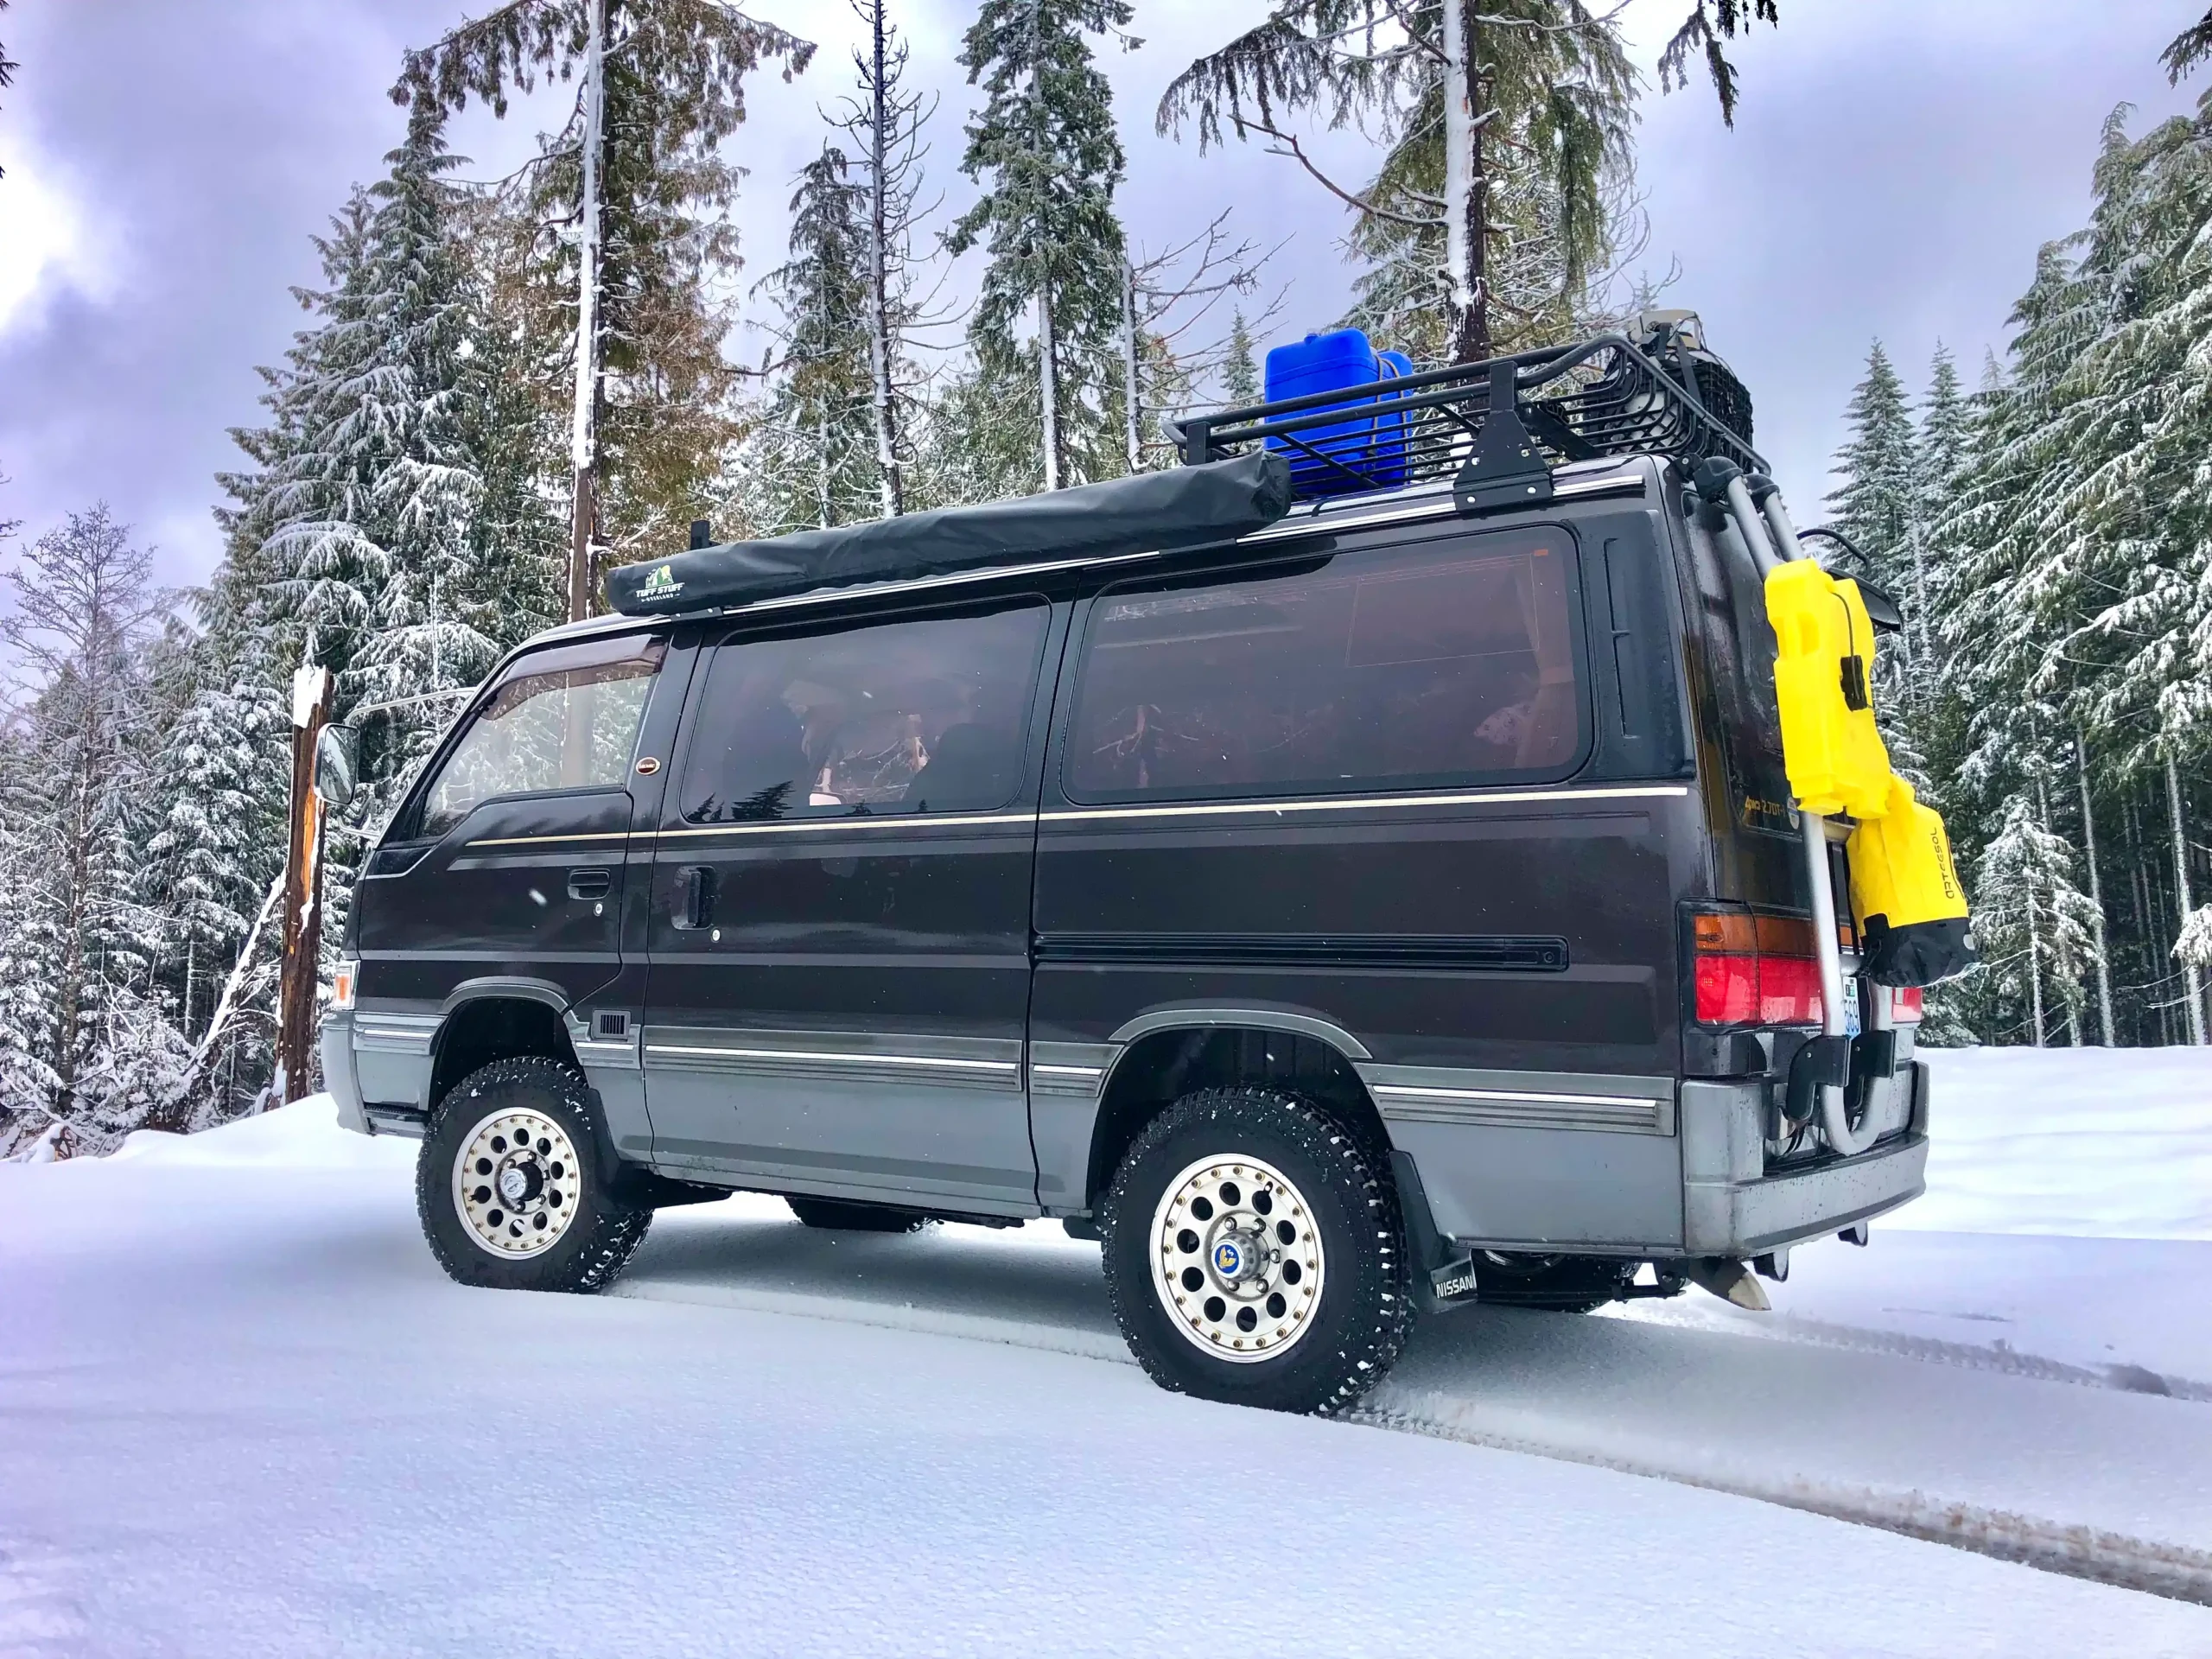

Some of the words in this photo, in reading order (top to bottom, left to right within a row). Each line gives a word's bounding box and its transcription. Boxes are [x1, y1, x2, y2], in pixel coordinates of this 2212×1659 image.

[636, 588, 657, 598] TUFF
[657, 583, 683, 594] STUFF
[646, 592, 674, 602] OVERLAND
[1436, 1275, 1473, 1299] NISSAN
